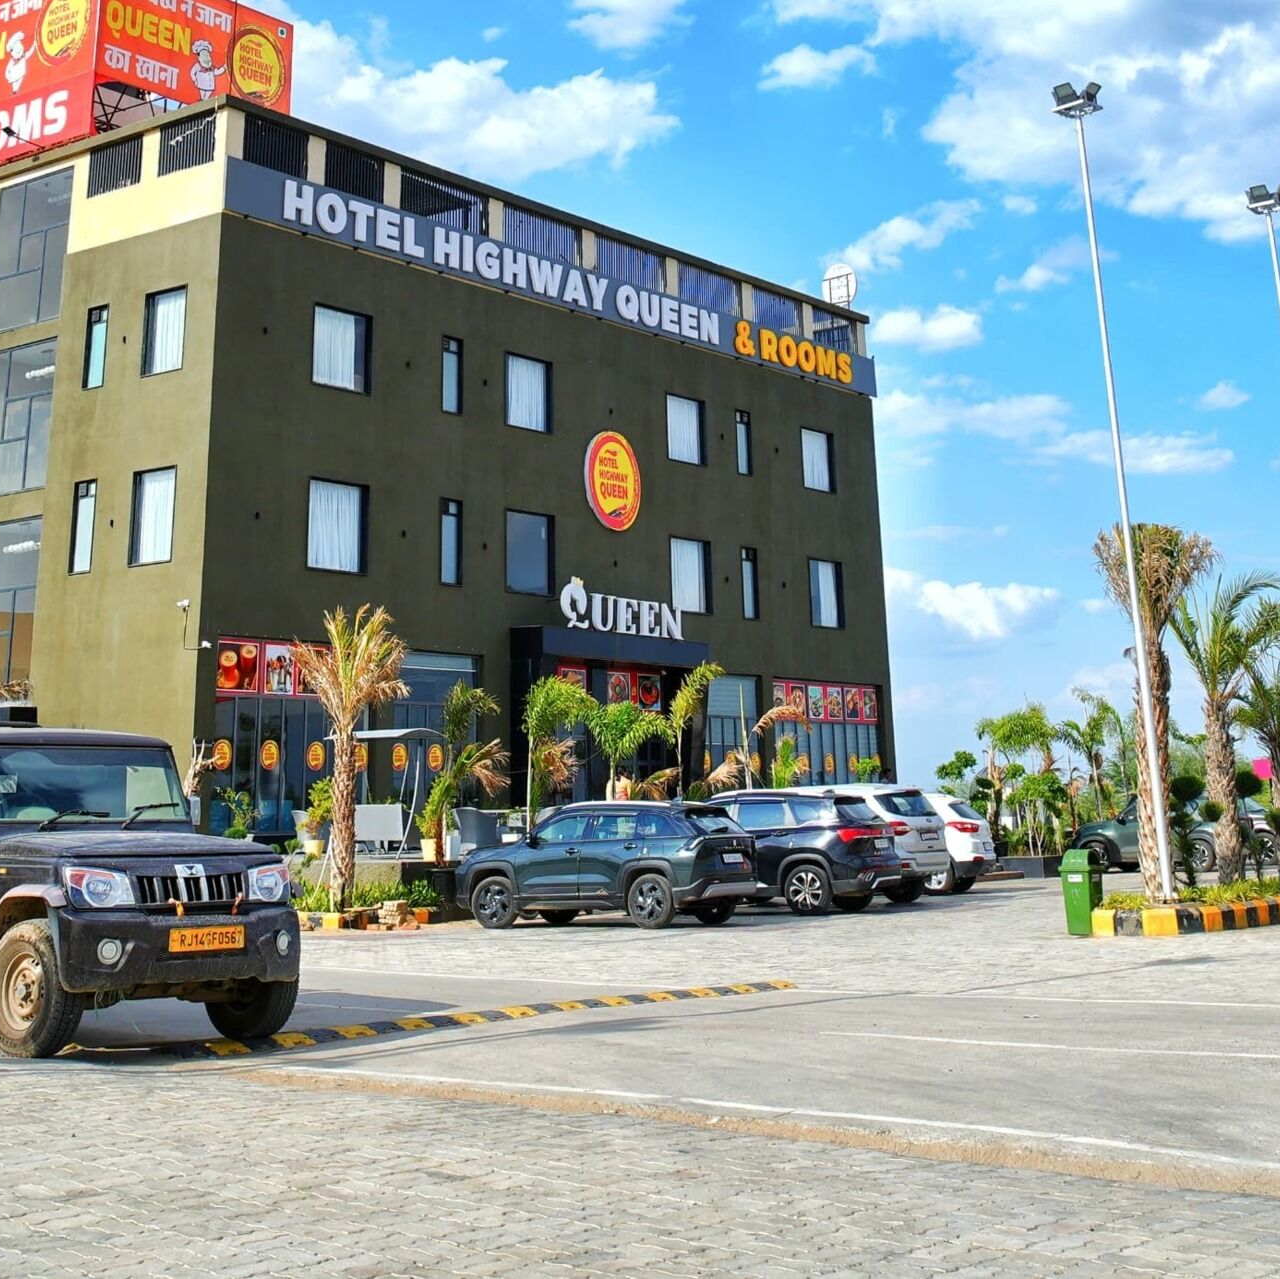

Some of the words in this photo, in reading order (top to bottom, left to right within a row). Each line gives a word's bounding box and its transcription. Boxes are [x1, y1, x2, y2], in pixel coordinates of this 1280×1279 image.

[0, 2, 10, 23] न
[47, 9, 79, 28] HIGHWAY
[49, 2, 70, 17] HOTEL
[195, 2, 233, 34] जाना
[46, 22, 78, 44] QUEEN
[106, 0, 191, 57] QUEEN
[239, 43, 263, 60] HOTEL
[104, 43, 132, 74] का
[135, 55, 180, 90] खाना
[239, 54, 273, 75] HIGHWAY
[239, 65, 272, 87] QUEEN
[283, 179, 425, 258] HOTEL
[433, 227, 608, 311] HIGHWAY
[615, 284, 720, 345] QUEEN
[734, 320, 756, 357] &
[759, 328, 853, 384] ROOMS
[598, 455, 619, 470] HOTEL
[598, 468, 628, 484] HIGHWAY
[600, 482, 628, 500] QUEEN
[560, 576, 685, 640] QUEEN
